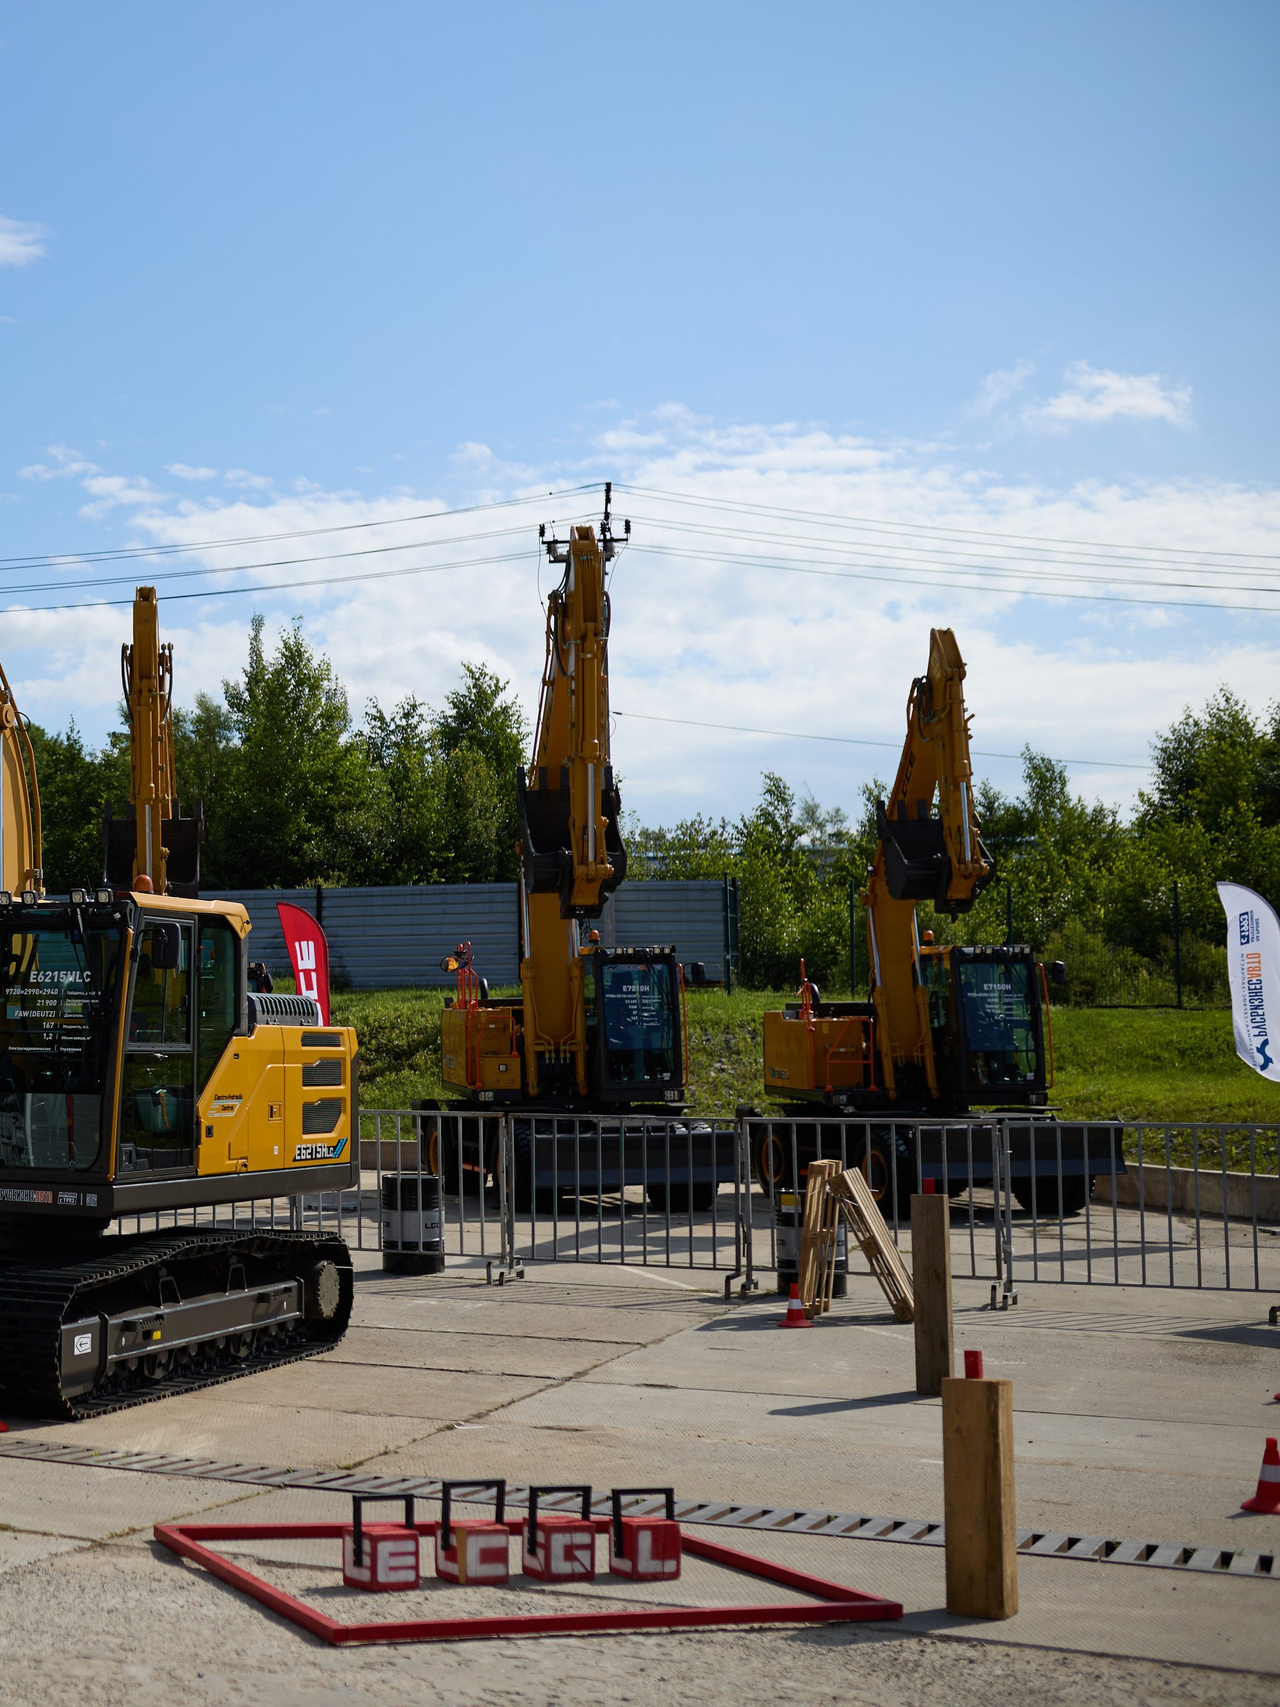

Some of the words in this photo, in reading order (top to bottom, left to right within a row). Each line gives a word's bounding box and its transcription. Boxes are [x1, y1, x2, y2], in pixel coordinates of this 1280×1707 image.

[901, 749, 916, 798] GCE
[29, 971, 91, 983] E6215HLC
[0, 1188, 53, 1203] РУСБИЗНЕСАВТО
[377, 1540, 417, 1583] E
[466, 1534, 508, 1578] C
[551, 1532, 592, 1575] G
[638, 1530, 678, 1573] L
